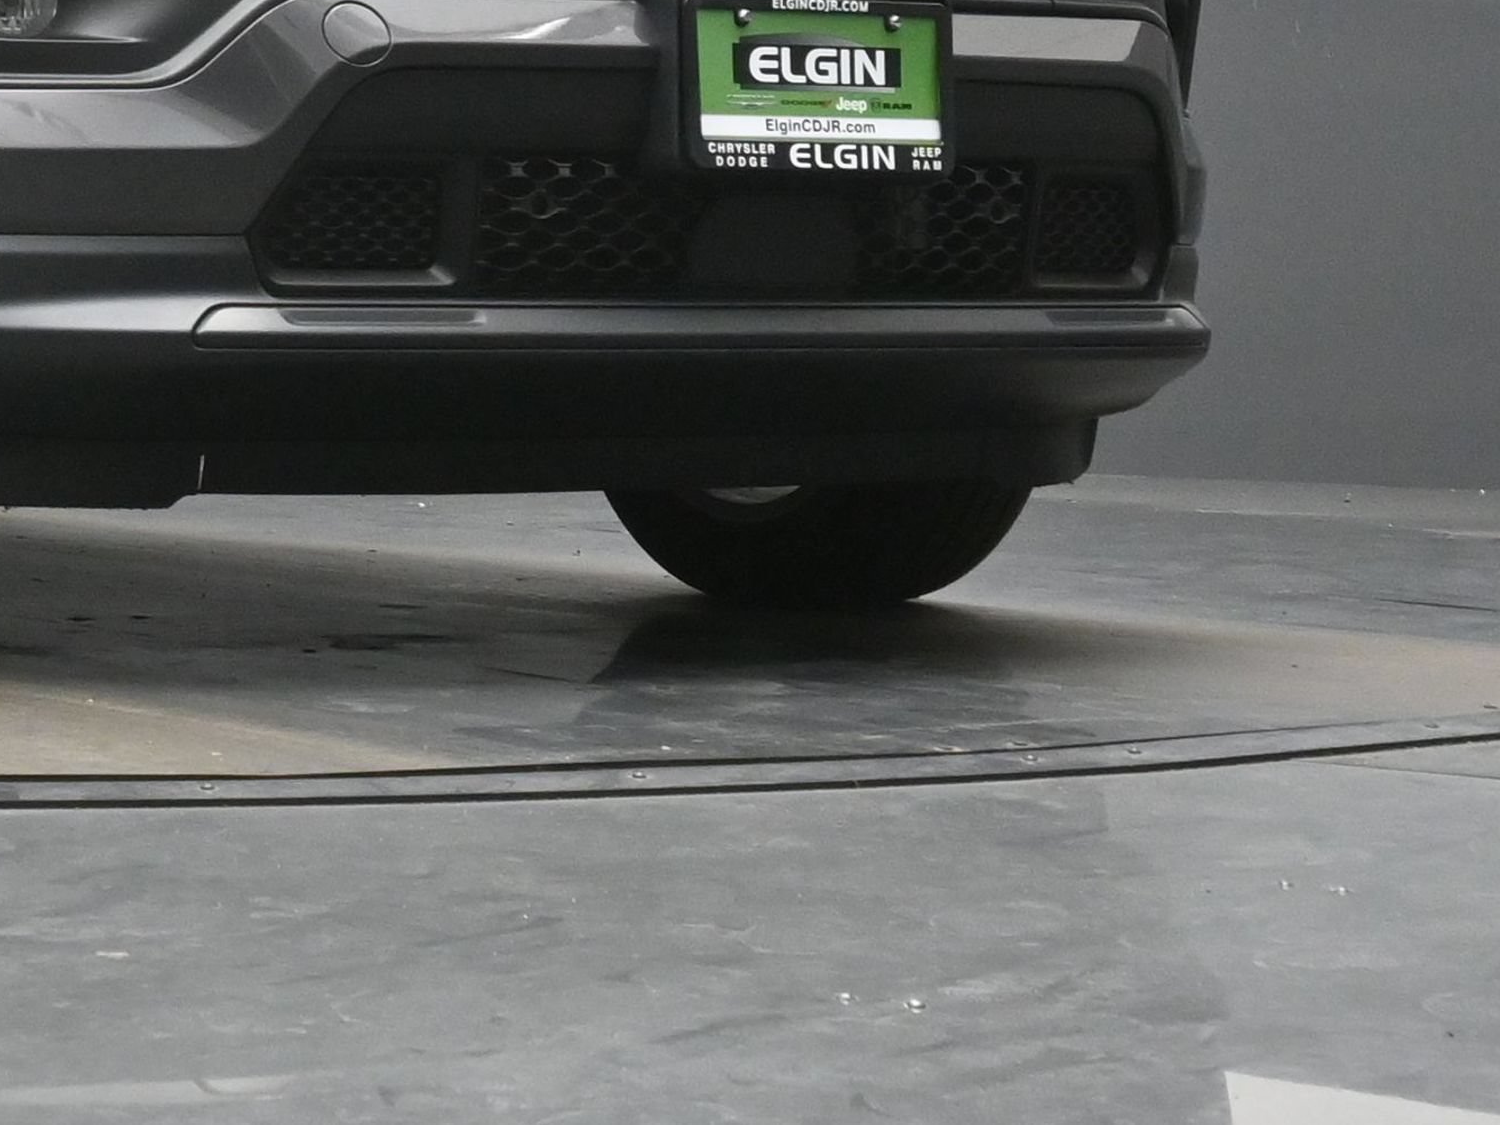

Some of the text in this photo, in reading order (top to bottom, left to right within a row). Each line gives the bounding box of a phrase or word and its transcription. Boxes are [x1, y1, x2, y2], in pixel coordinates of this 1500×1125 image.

[748, 45, 887, 86] ELGIN
[835, 96, 868, 114] Jeep
[882, 102, 913, 111] RAM
[765, 118, 876, 135] ElginCDJR.com
[707, 141, 776, 155] CHRYSLER
[911, 146, 943, 159] JEEP
[715, 155, 769, 168] DODGE
[788, 142, 896, 171] ELGIN
[912, 159, 943, 172] RAM
